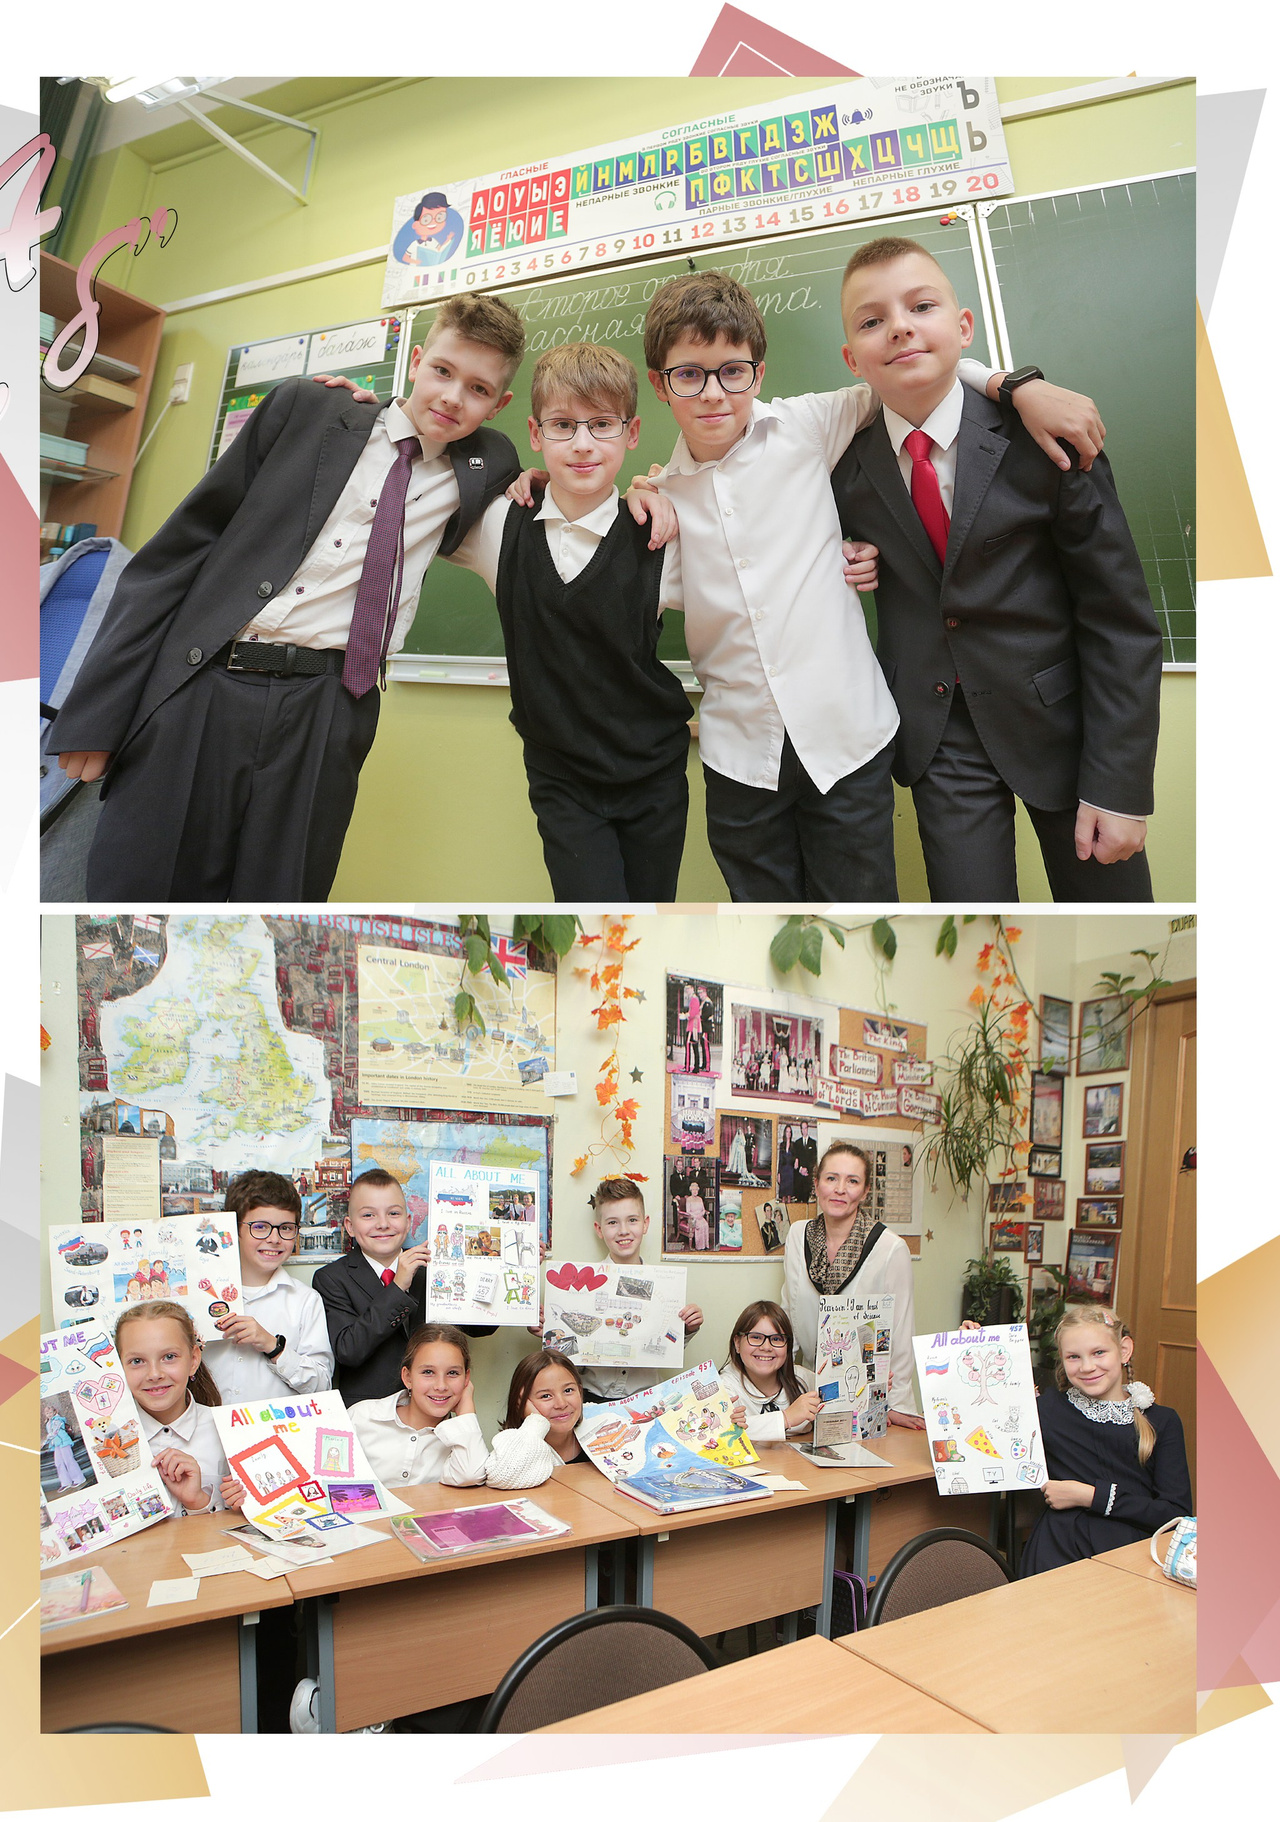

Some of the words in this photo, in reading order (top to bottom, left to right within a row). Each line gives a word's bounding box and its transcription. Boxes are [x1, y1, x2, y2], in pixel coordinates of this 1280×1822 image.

[920, 83, 953, 96] ЗВУКИ
[957, 80, 980, 110] Ъ
[662, 114, 736, 140] СОГЛАСНЫЕ
[690, 142, 703, 166] Б
[714, 136, 727, 160] В
[740, 131, 752, 155] Г
[764, 123, 781, 152] Д
[791, 120, 805, 144] З
[812, 111, 837, 139] Ж
[966, 121, 987, 153] Ь
[851, 144, 865, 171] Х
[876, 136, 896, 165] Ц
[906, 133, 924, 158] Ч
[930, 125, 959, 155] Щ
[500, 162, 549, 181] ГЛАСНЫЕ
[576, 165, 588, 193] Й
[598, 165, 610, 187] Н
[619, 159, 633, 182] М
[642, 154, 656, 177] Л
[666, 149, 678, 172] Р
[690, 178, 704, 203] П
[713, 172, 731, 196] Ф
[741, 168, 755, 193] К
[767, 163, 781, 188] Т
[794, 158, 809, 183] С
[817, 150, 841, 178] Ш
[852, 169, 915, 187] НЕПАРНЫЕ
[917, 161, 961, 176] ГЛУХИЕ
[473, 196, 485, 218] А
[493, 190, 505, 212] О
[514, 186, 526, 207] У
[531, 180, 547, 203] Ы
[554, 176, 567, 198] Э
[575, 189, 630, 209] НЕПАРНЫЕ
[632, 179, 680, 196] ЗВОНКИЕ
[699, 201, 741, 216] ПАРНЫЕ
[742, 185, 833, 209] ЗВОНКИЕ/ГЛУХИЕ
[466, 271, 476, 286] 0
[481, 268, 489, 282] 1
[495, 265, 505, 279] 2
[510, 261, 521, 275] 3
[527, 257, 538, 271] 4
[544, 254, 554, 268] 5
[561, 250, 572, 264] 6
[579, 246, 589, 261] 7
[595, 242, 607, 257] 8
[613, 239, 625, 253] 9
[633, 233, 655, 250] 10
[663, 228, 683, 244] 11
[691, 222, 714, 239] 12
[722, 216, 746, 234] 13
[755, 211, 780, 229] 14
[789, 205, 814, 224] 15
[823, 198, 850, 217] 16
[858, 192, 883, 211] 17
[893, 186, 920, 204] 18
[930, 179, 957, 198] 19
[966, 172, 999, 192] 20
[470, 228, 482, 252] Я
[489, 222, 502, 248] Ё
[508, 219, 525, 243] Ю
[530, 214, 543, 238] И
[552, 209, 564, 233] Е
[318, 914, 403, 940] BRITISH
[412, 927, 463, 950] ISLES
[366, 955, 398, 966] Central
[400, 959, 430, 971] London
[868, 1033, 881, 1042] The
[883, 1036, 903, 1050] King
[839, 1048, 851, 1059] The
[853, 1051, 877, 1064] British
[362, 1072, 385, 1080] Important
[423, 1075, 439, 1083] history
[839, 1061, 877, 1078] Parliament
[820, 1081, 833, 1091] The
[835, 1083, 858, 1097] House
[865, 1092, 880, 1101] The
[818, 1090, 826, 1099] of
[828, 1091, 858, 1108] Lords
[865, 1103, 872, 1113] of
[435, 1166, 457, 1179] ALL
[463, 1169, 500, 1182] ABOUT
[510, 1173, 526, 1185] ME
[63, 1331, 86, 1347] ME
[930, 1331, 948, 1348] All
[950, 1328, 986, 1346] about
[988, 1333, 1000, 1342] me
[619, 1394, 640, 1406] ABOUT
[643, 1388, 654, 1397] ME
[231, 1407, 255, 1427] All
[259, 1399, 323, 1422] about
[272, 1421, 301, 1434] me
[127, 1488, 142, 1499] Daily
[143, 1483, 153, 1492] life
